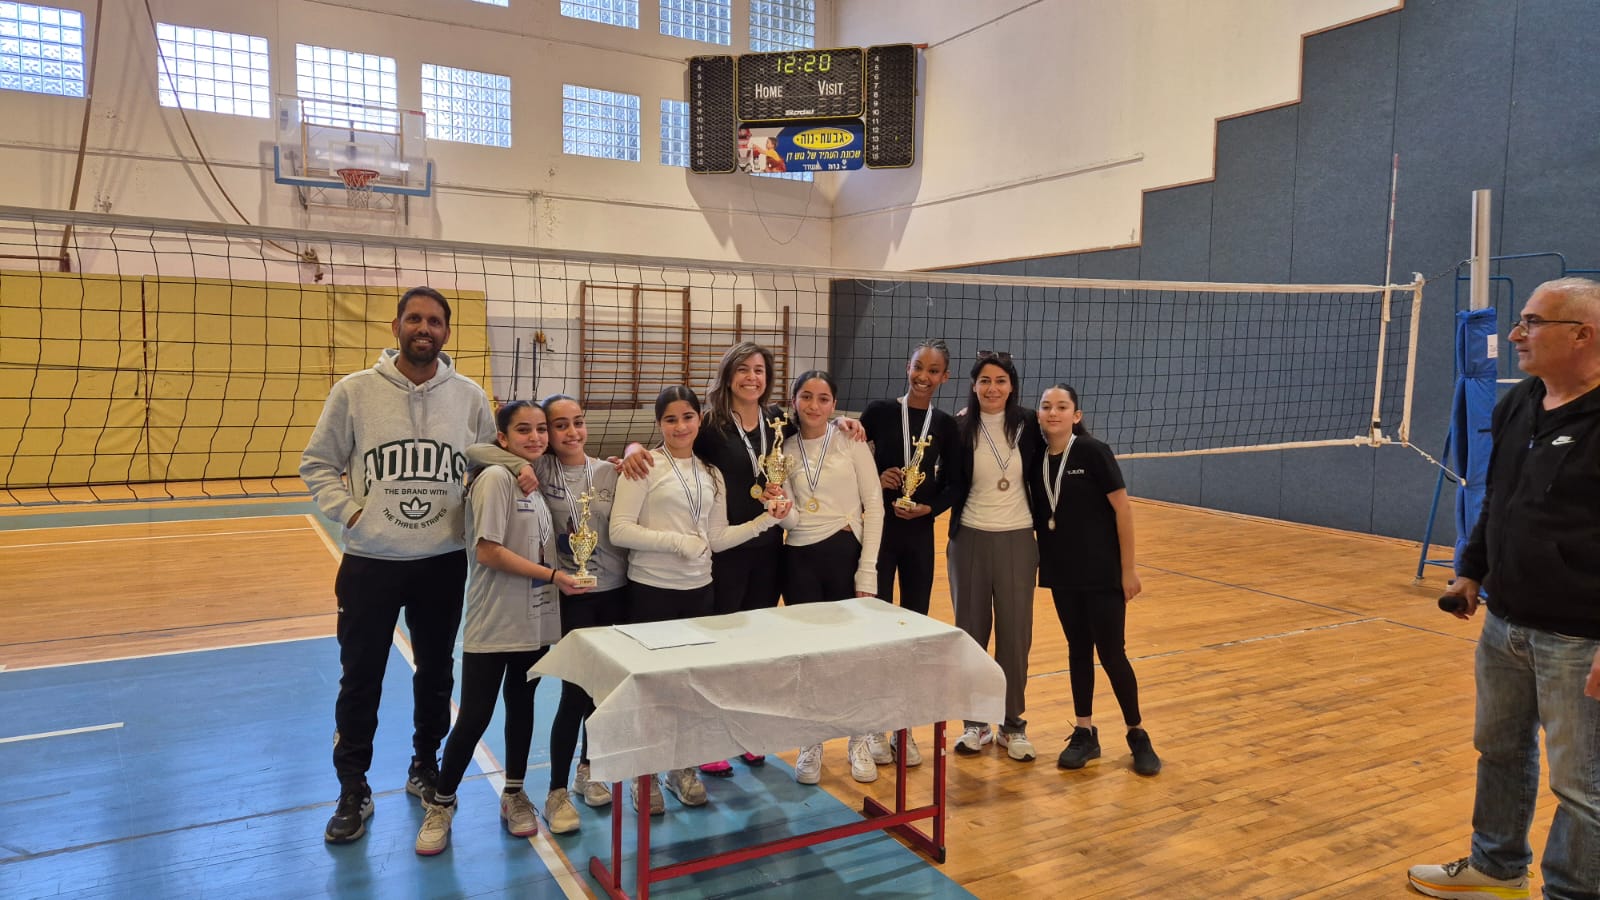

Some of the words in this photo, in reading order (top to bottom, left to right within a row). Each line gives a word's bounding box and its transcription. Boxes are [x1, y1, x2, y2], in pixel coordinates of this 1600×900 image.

[777, 54, 831, 74] 12:20
[807, 150, 816, 160] של
[840, 150, 861, 158] שכונת
[364, 438, 467, 494] ADIDAS
[382, 507, 393, 522] THE
[394, 518, 419, 529] THREE
[421, 508, 448, 528] STRIPES
